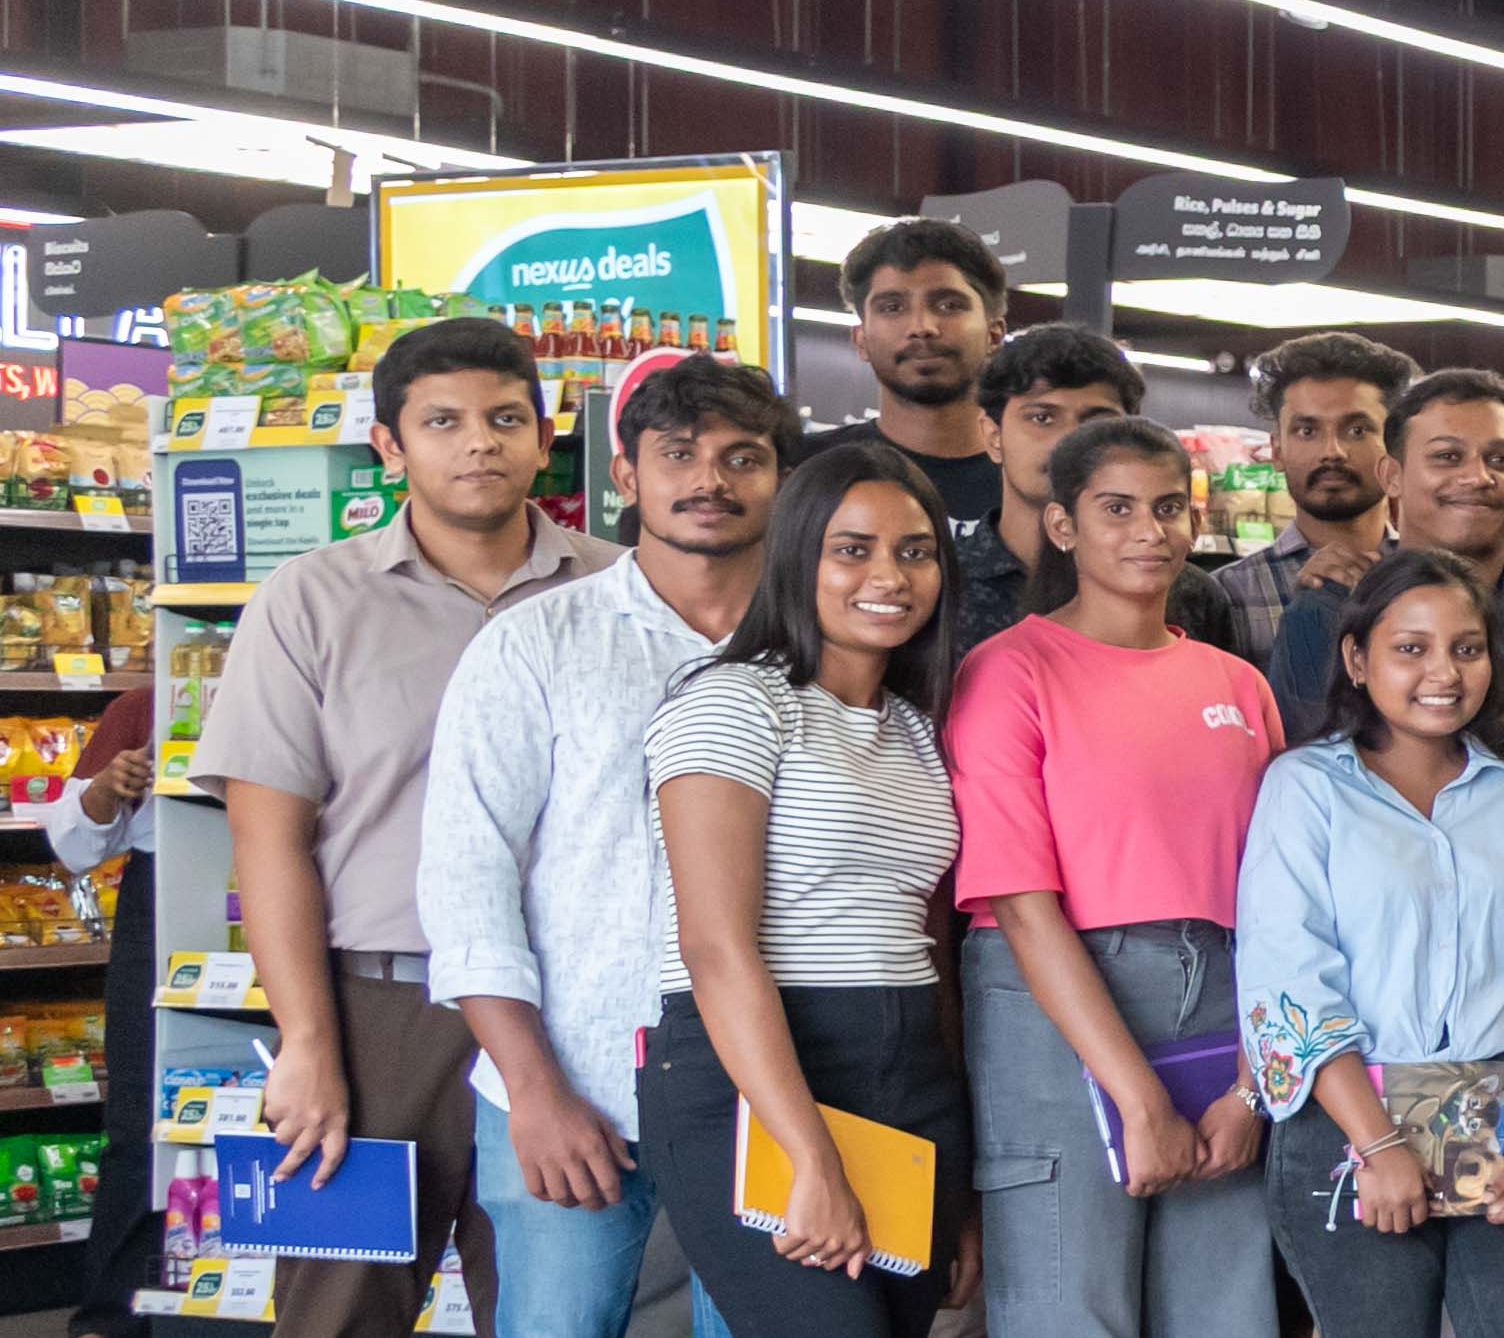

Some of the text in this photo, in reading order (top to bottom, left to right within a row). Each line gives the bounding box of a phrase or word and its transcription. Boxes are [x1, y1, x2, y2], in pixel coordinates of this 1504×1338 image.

[1174, 195, 1210, 214] Rice,
[1212, 198, 1260, 214] Pulses
[1276, 201, 1322, 221] Sugar
[512, 242, 672, 288] nexus deals
[347, 506, 379, 520] MILO
